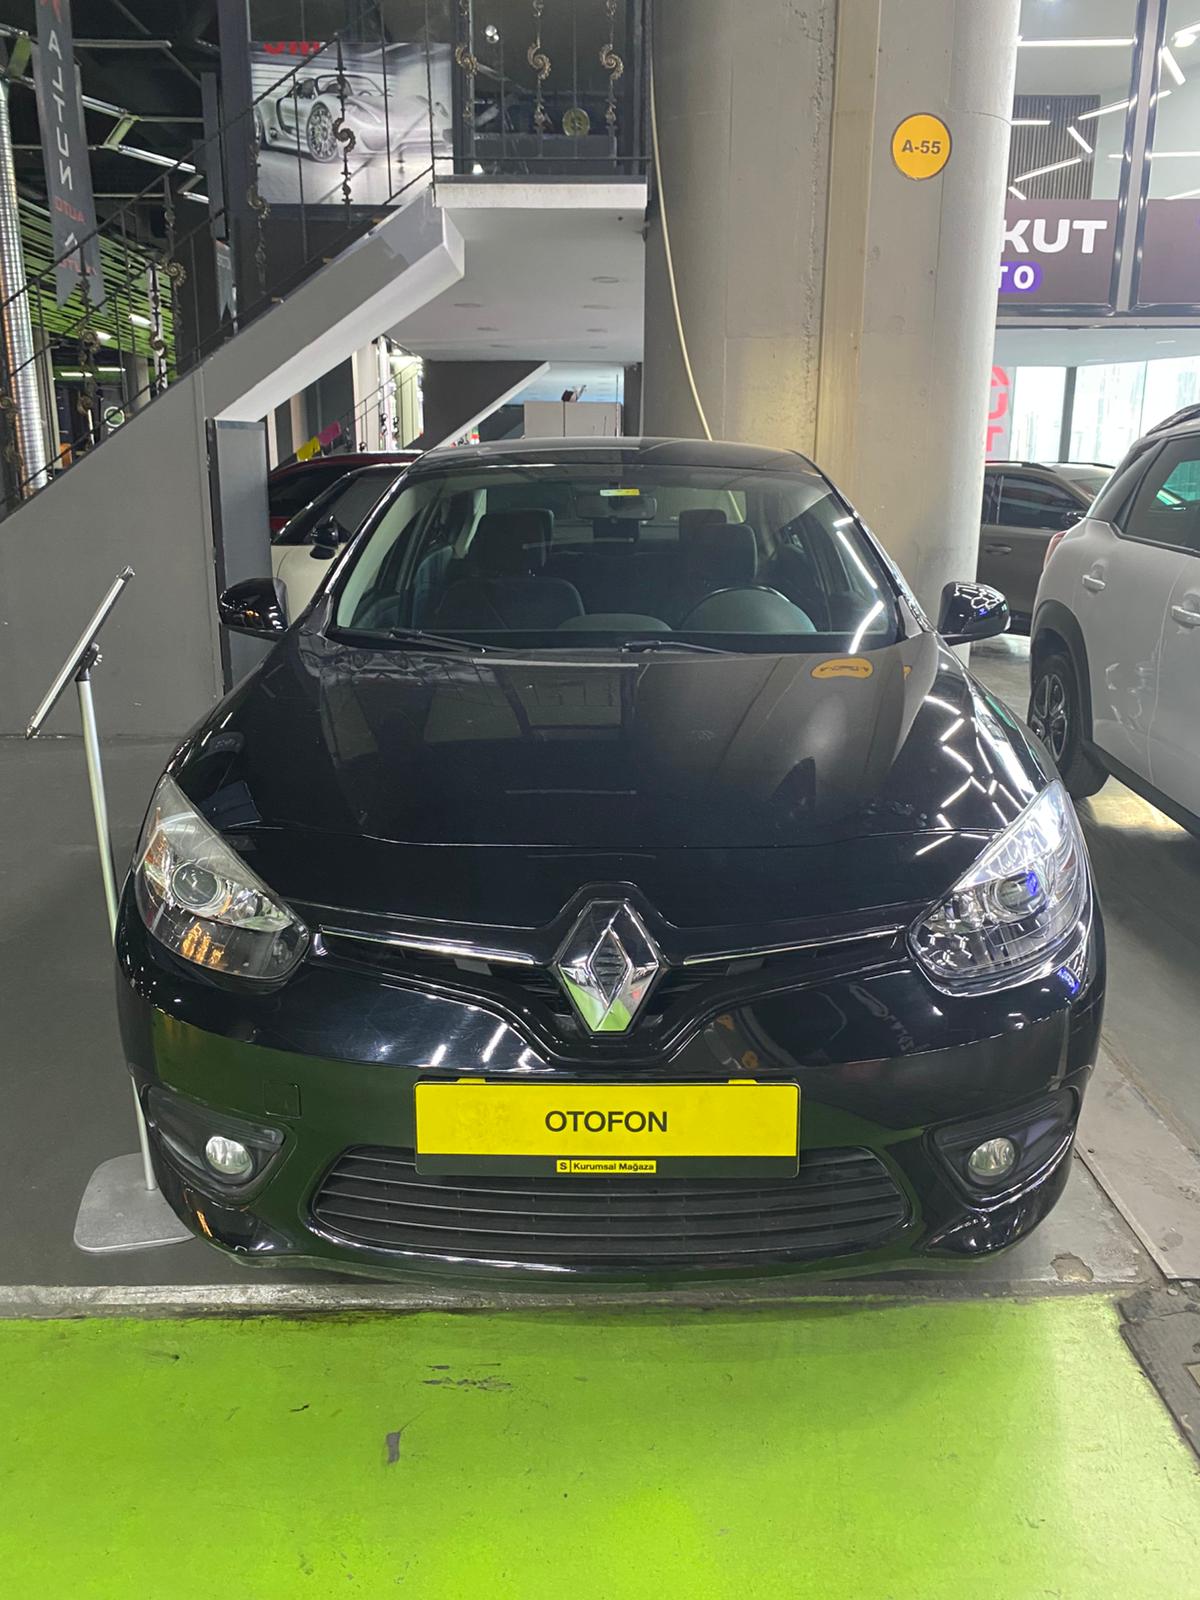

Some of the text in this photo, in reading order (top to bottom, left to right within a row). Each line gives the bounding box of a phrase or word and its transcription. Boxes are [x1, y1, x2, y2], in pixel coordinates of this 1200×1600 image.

[902, 139, 941, 155] A-55
[545, 1110, 668, 1132] OTOFON
[559, 1162, 654, 1172] S Kurumsal Mağaza
